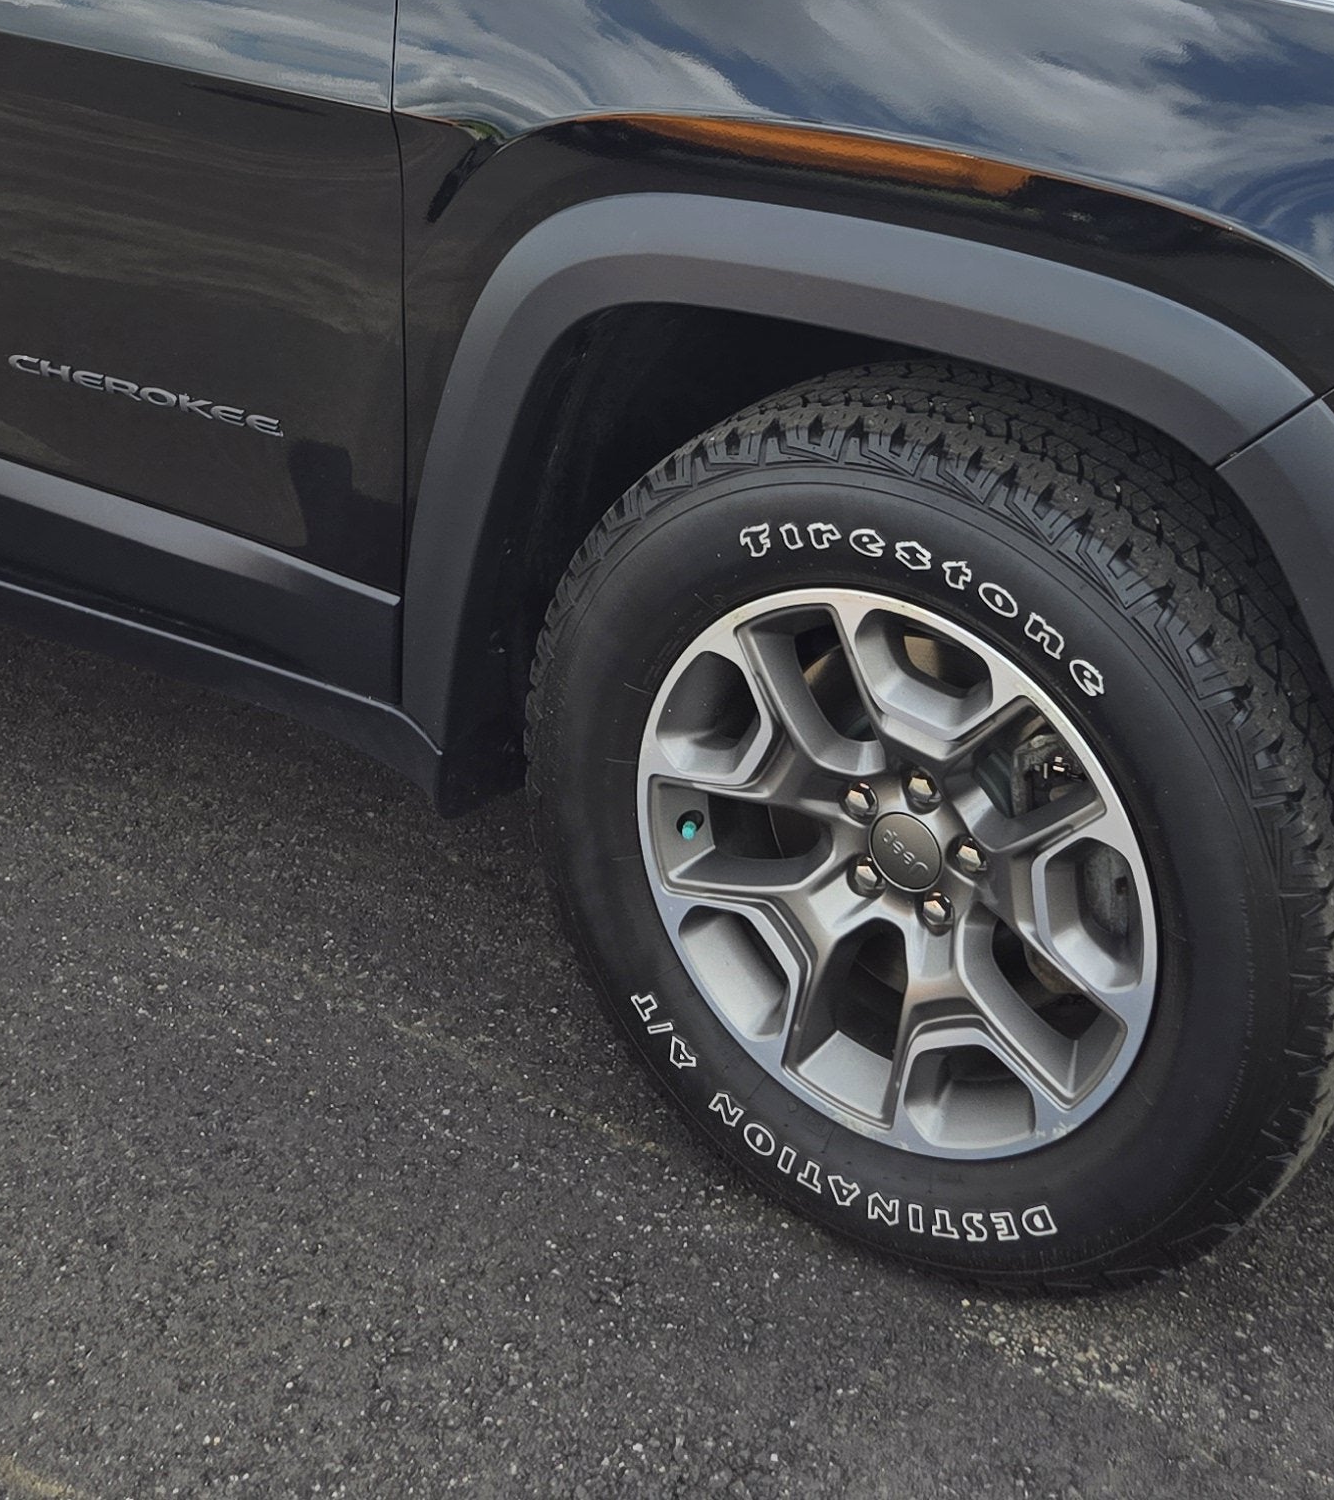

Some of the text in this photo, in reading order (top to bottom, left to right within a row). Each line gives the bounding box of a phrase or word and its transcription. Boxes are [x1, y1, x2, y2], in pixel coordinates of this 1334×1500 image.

[8, 354, 284, 437] CHEROKEE
[740, 521, 1107, 698] Firestone
[630, 991, 1059, 1242] DESTINATION A/T
